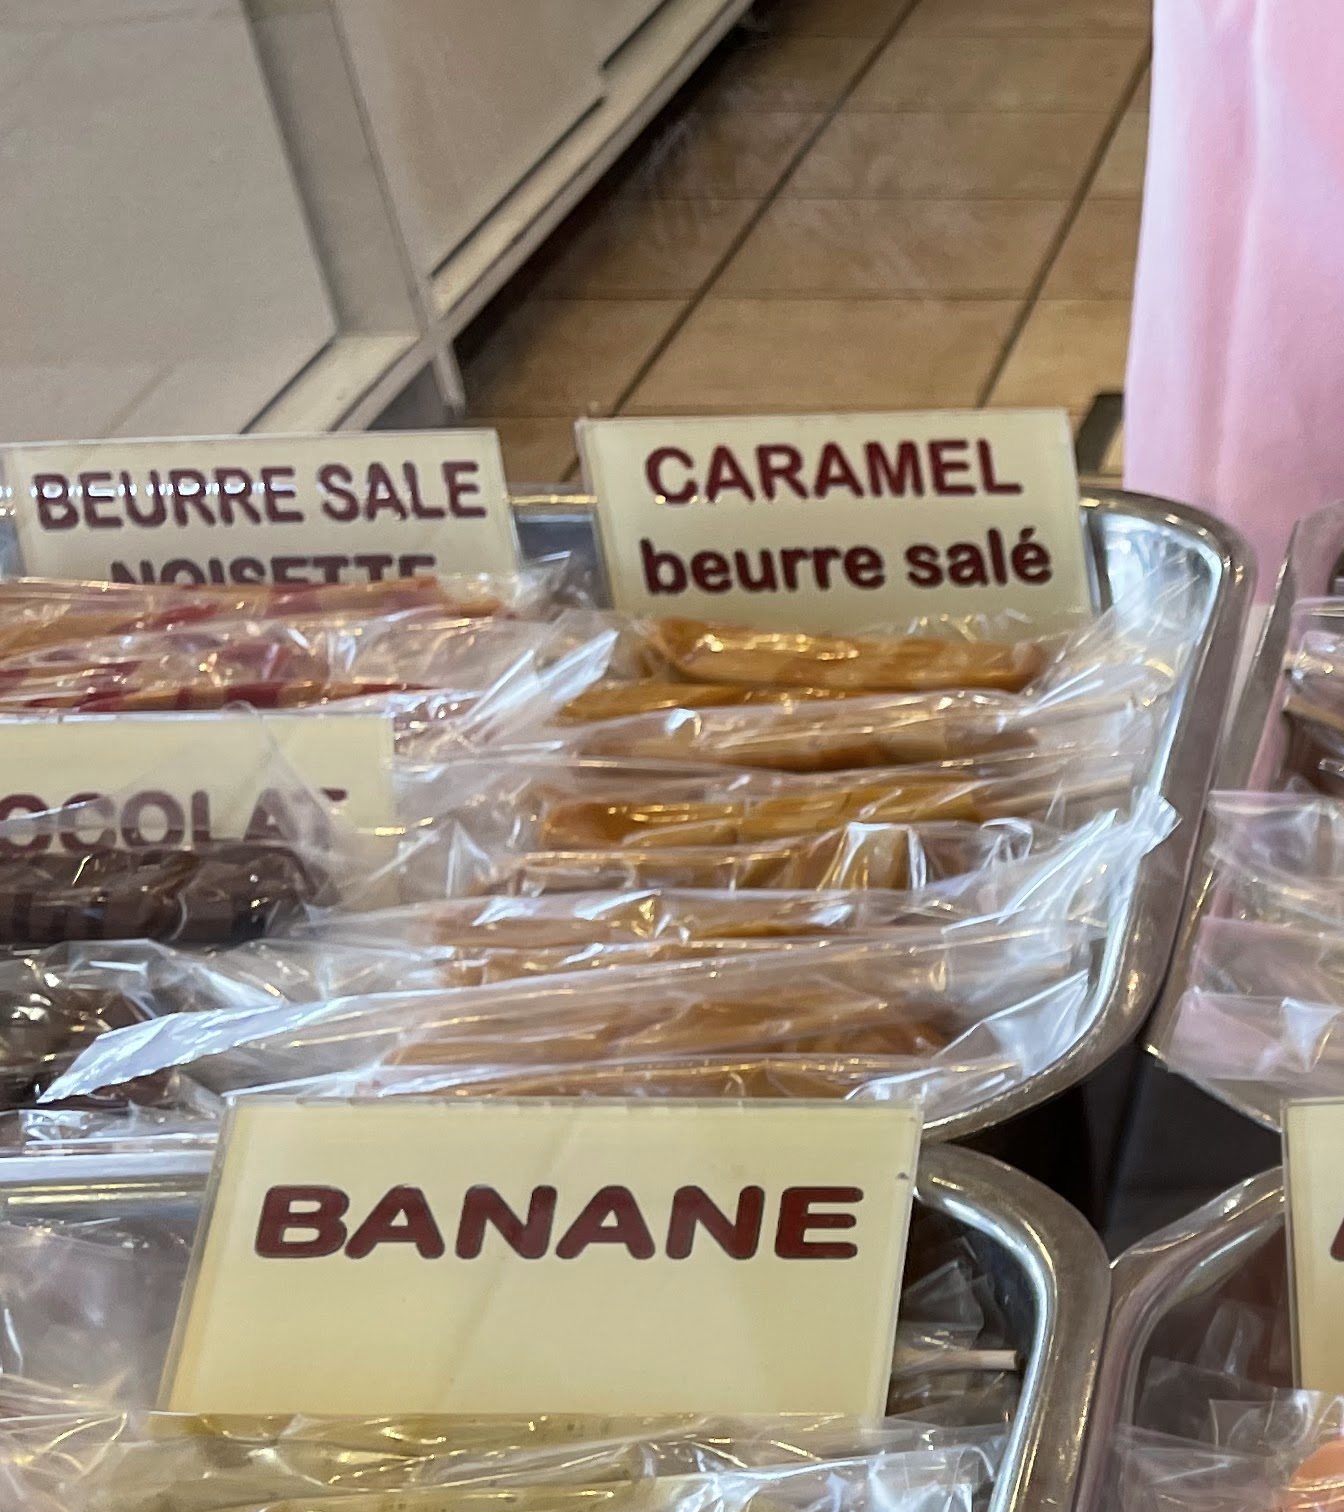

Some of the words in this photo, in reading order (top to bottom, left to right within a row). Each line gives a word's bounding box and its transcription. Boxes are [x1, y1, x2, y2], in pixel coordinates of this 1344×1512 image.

[34, 467, 304, 530] BEURRE
[318, 462, 486, 522] SALE
[646, 440, 1022, 504] CARAMEL
[641, 539, 885, 595] beurre
[905, 528, 1052, 584] salé
[255, 1185, 863, 1260] BANANE
